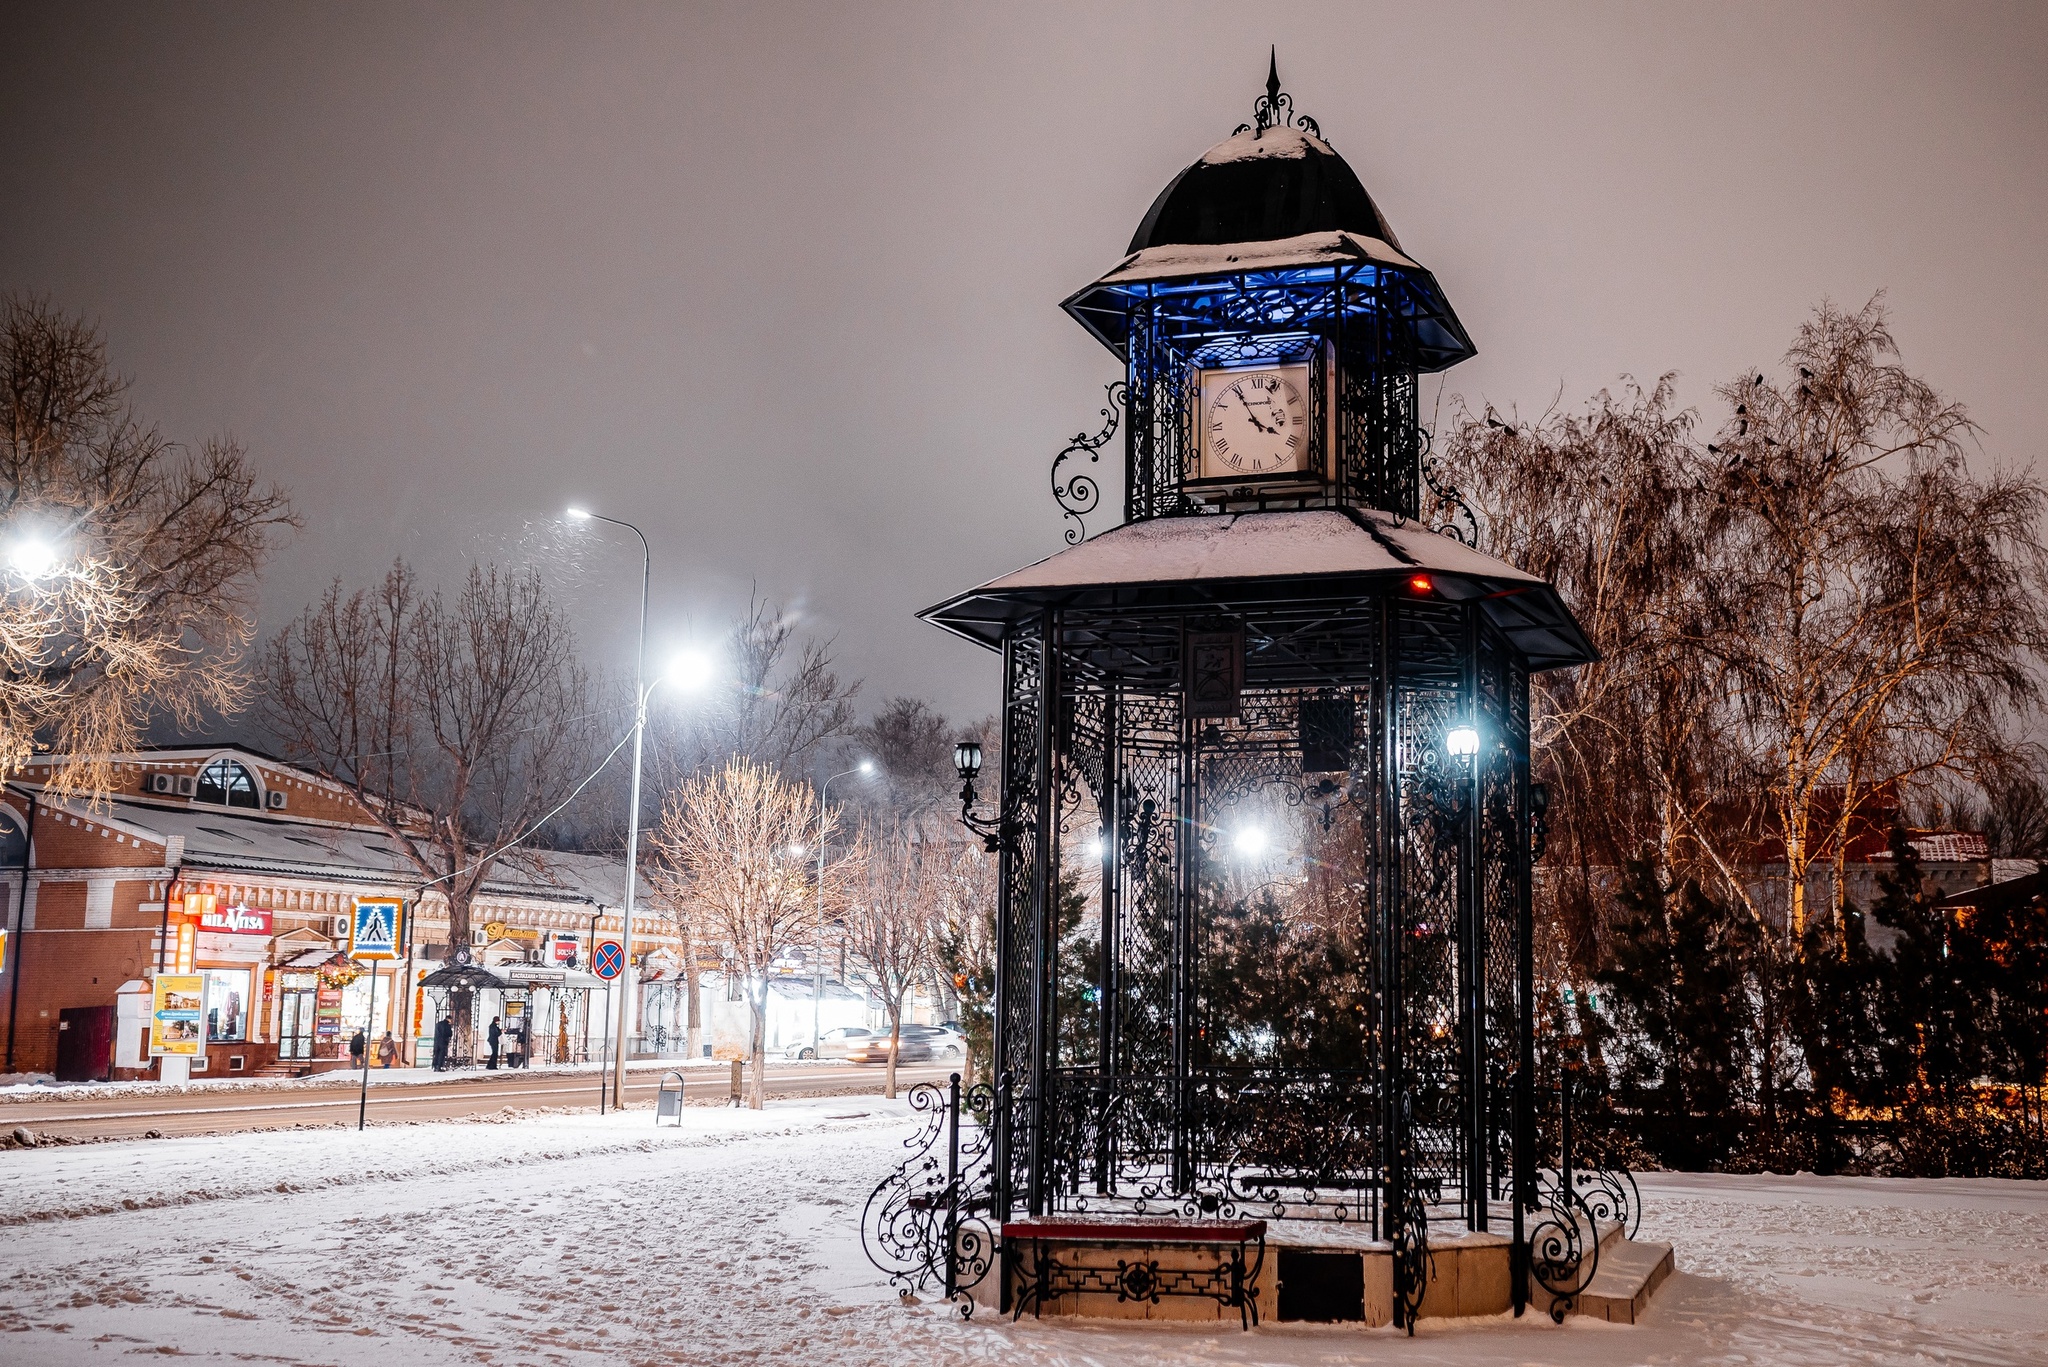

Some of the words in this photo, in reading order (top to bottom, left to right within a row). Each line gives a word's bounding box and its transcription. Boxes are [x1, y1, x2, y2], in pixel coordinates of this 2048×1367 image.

[1251, 379, 1263, 389] XII
[1287, 396, 1298, 406] II
[1292, 416, 1303, 425] III
[1216, 438, 1230, 454] VIII
[1230, 453, 1243, 467] VII
[1253, 459, 1262, 469] VI
[414, 969, 426, 1038] САВЯНКА
